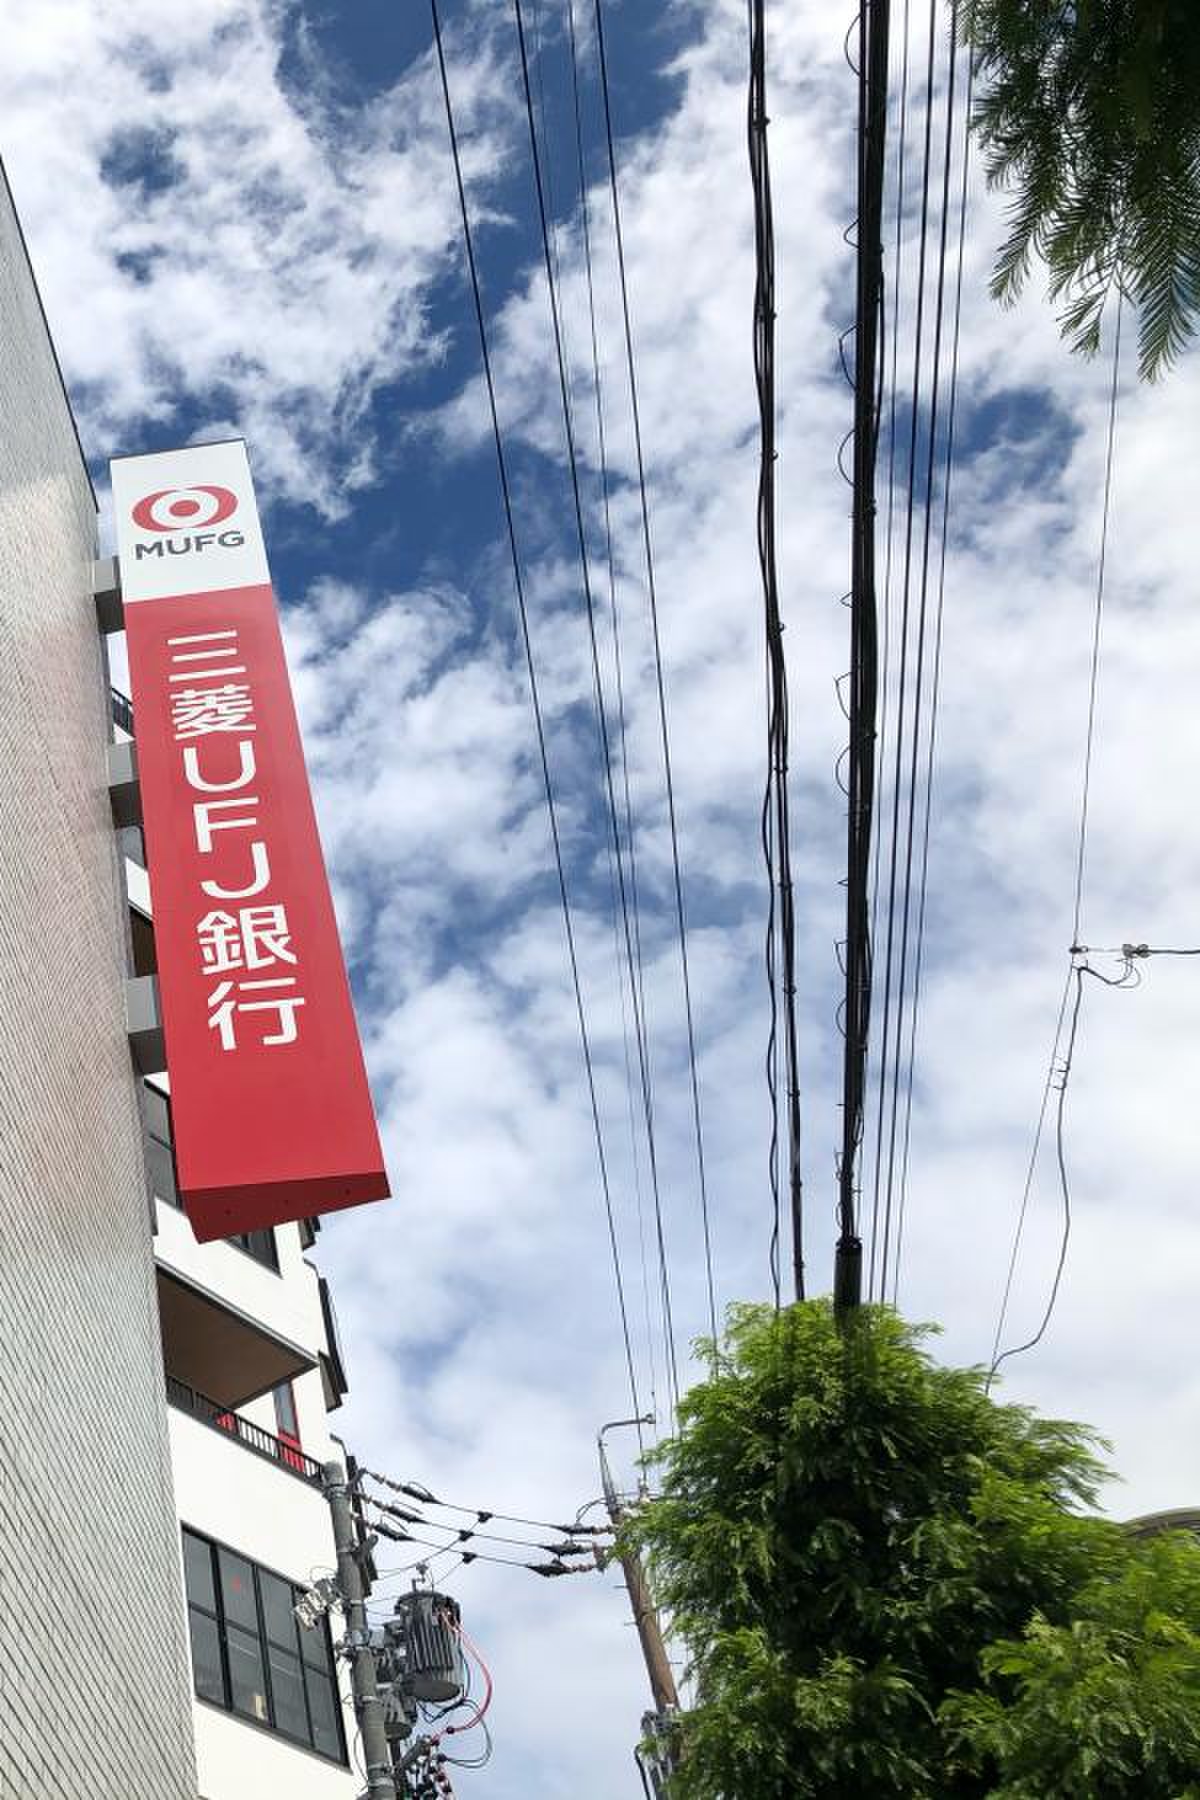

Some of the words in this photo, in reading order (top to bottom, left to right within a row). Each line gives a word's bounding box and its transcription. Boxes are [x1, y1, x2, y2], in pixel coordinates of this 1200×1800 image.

[135, 531, 245, 560] MUFG
[168, 630, 305, 1050] 三菱UFJ銀行
